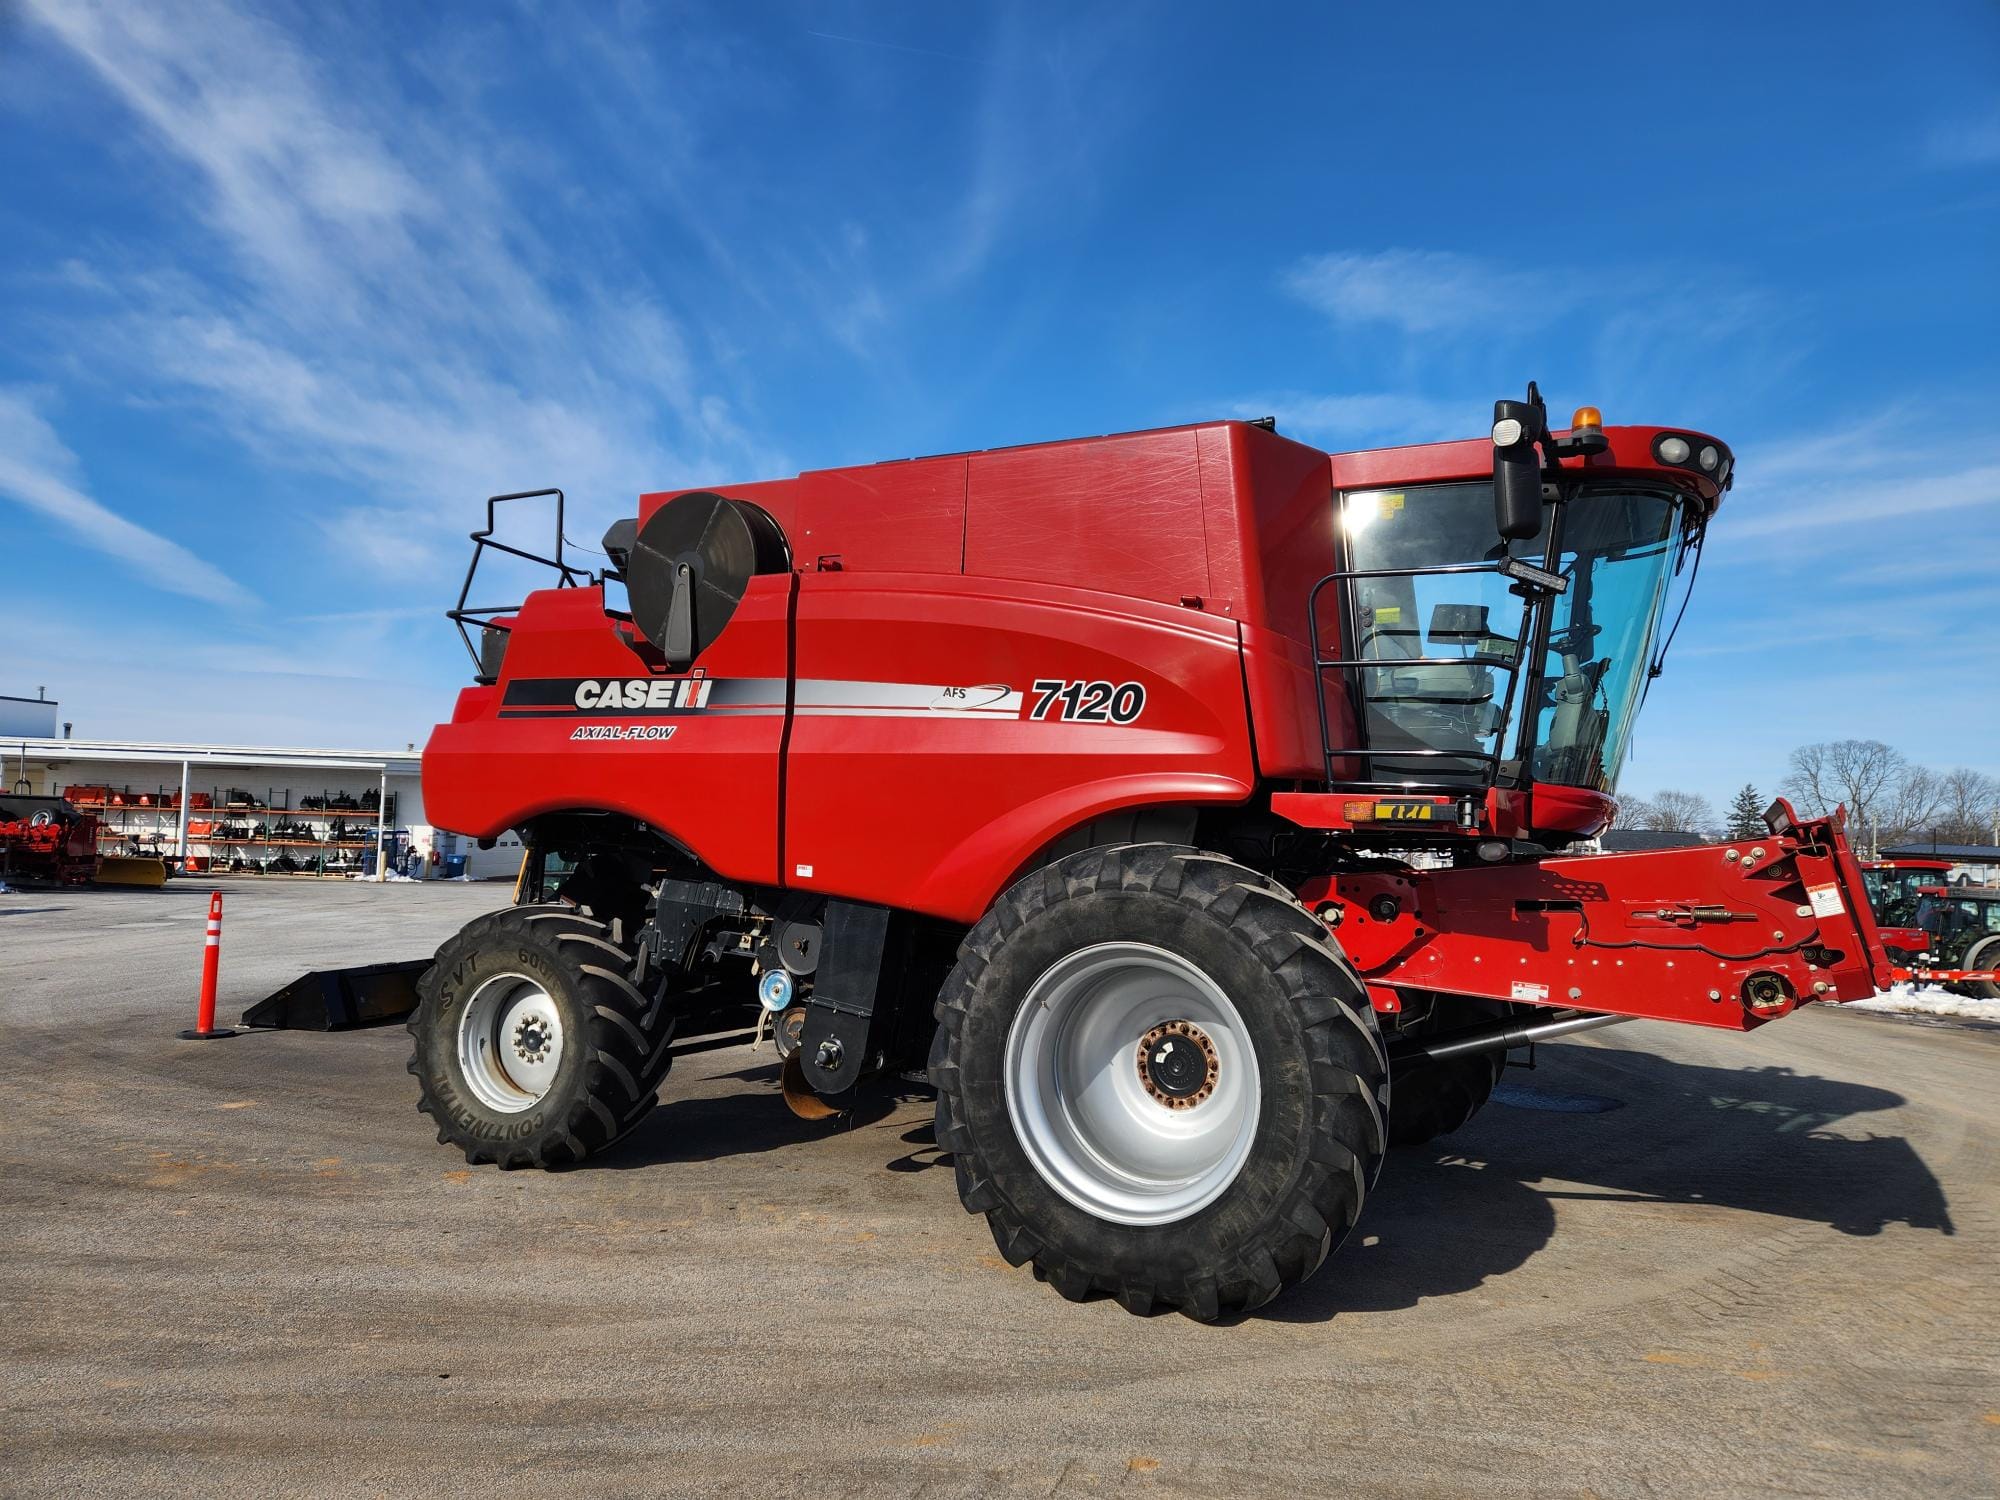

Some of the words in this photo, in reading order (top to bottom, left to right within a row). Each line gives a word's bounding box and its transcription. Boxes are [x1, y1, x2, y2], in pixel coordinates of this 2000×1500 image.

[574, 679, 675, 709] CASE
[942, 686, 967, 699] AFS
[1029, 679, 1147, 725] 7120
[570, 726, 677, 740] AXIAL-FLOW
[438, 950, 481, 1010] SVT
[431, 1073, 545, 1141] CONTINENTAL
